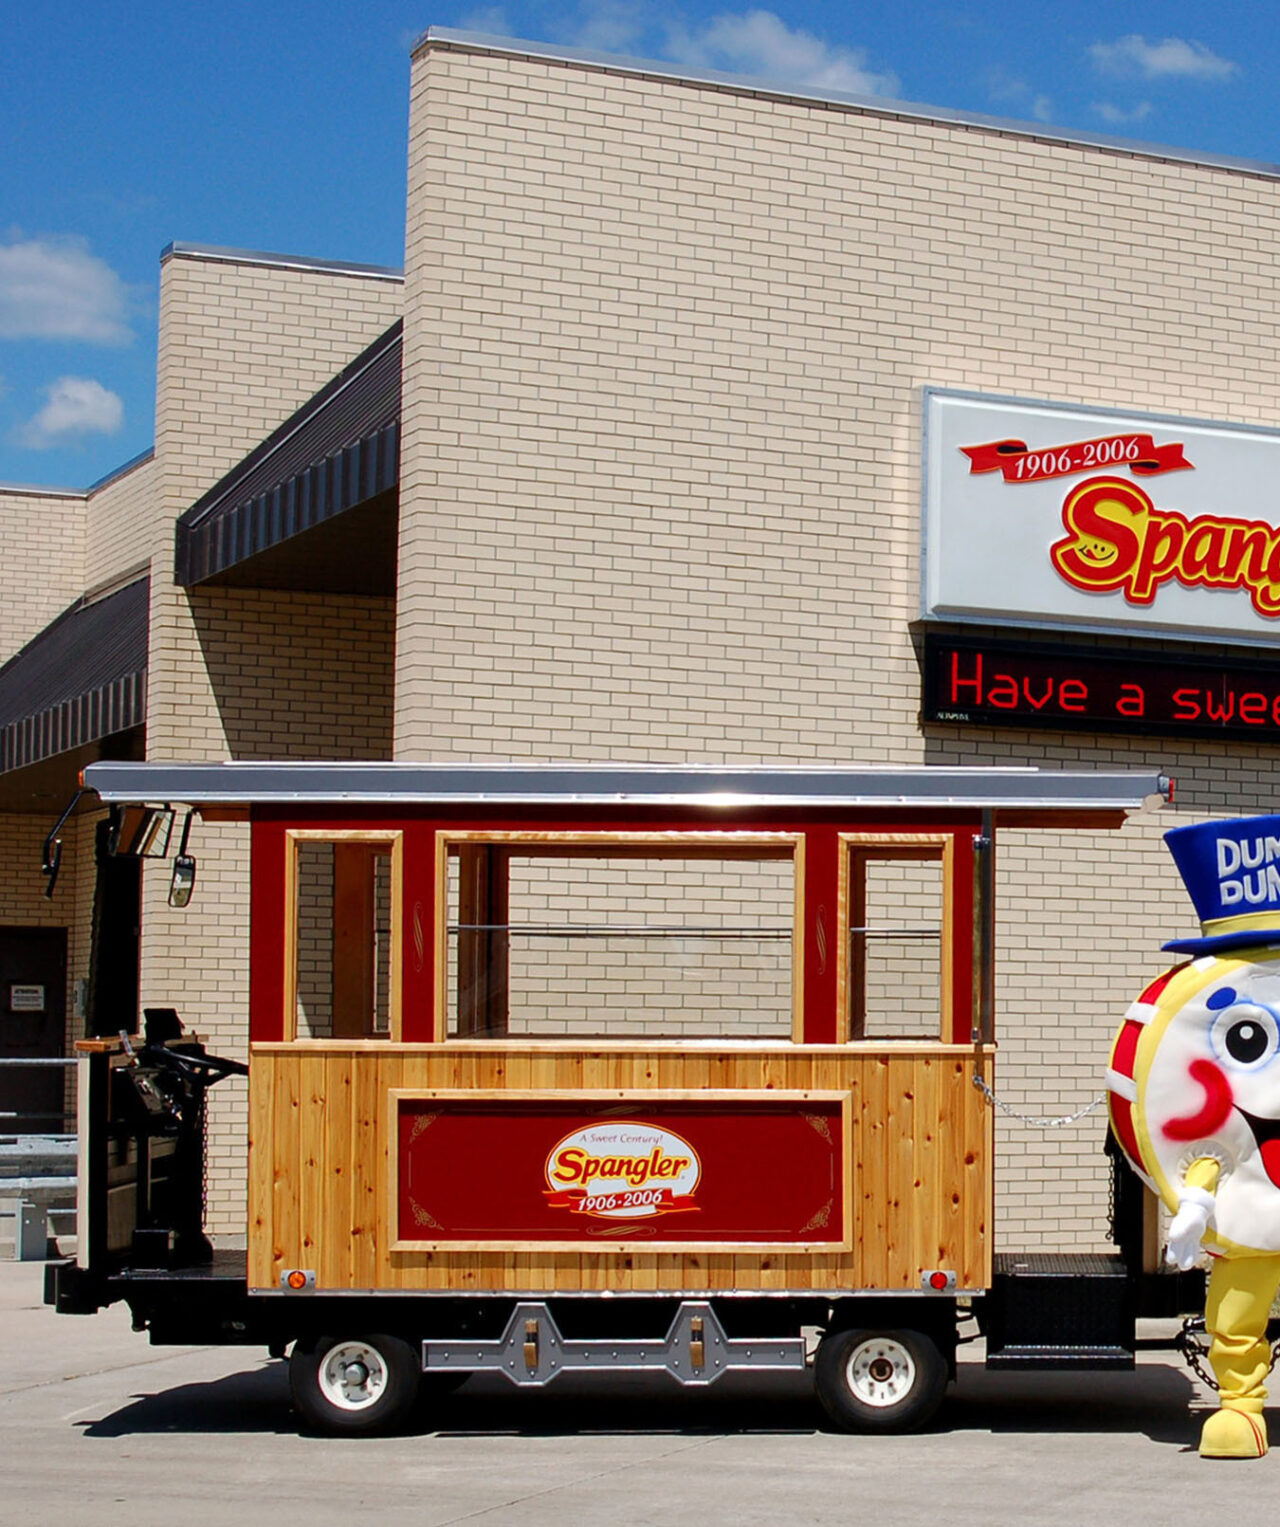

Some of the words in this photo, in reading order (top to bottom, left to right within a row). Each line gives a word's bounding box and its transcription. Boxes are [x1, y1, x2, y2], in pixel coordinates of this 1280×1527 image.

[1014, 437, 1140, 479] 1906-2006
[950, 651, 1089, 712] Have
[1115, 683, 1145, 717] a
[579, 1133, 588, 1143] A
[590, 1133, 618, 1144] Sweet
[620, 1133, 664, 1146] Century!
[551, 1146, 691, 1188] Spangler
